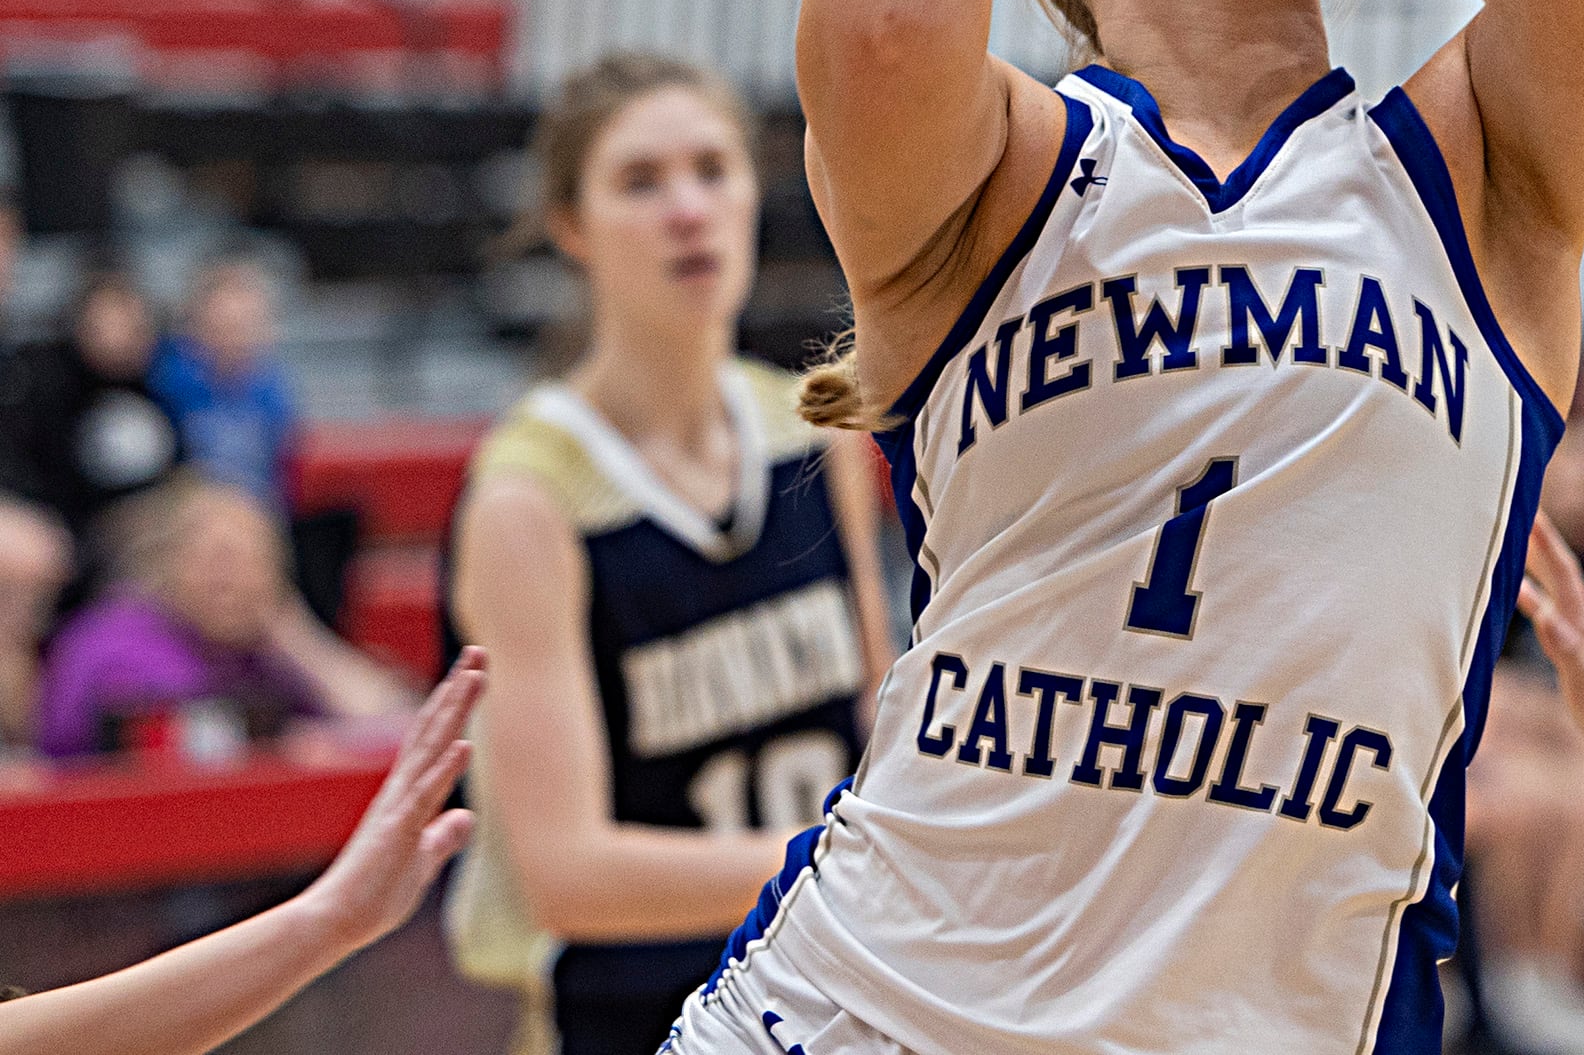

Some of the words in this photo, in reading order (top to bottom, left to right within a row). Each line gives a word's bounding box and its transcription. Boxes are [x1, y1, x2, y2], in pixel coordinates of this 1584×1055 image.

[957, 263, 1471, 463] NEWMAN
[1122, 456, 1239, 641] 1
[915, 650, 1394, 832] CATHOLIC
